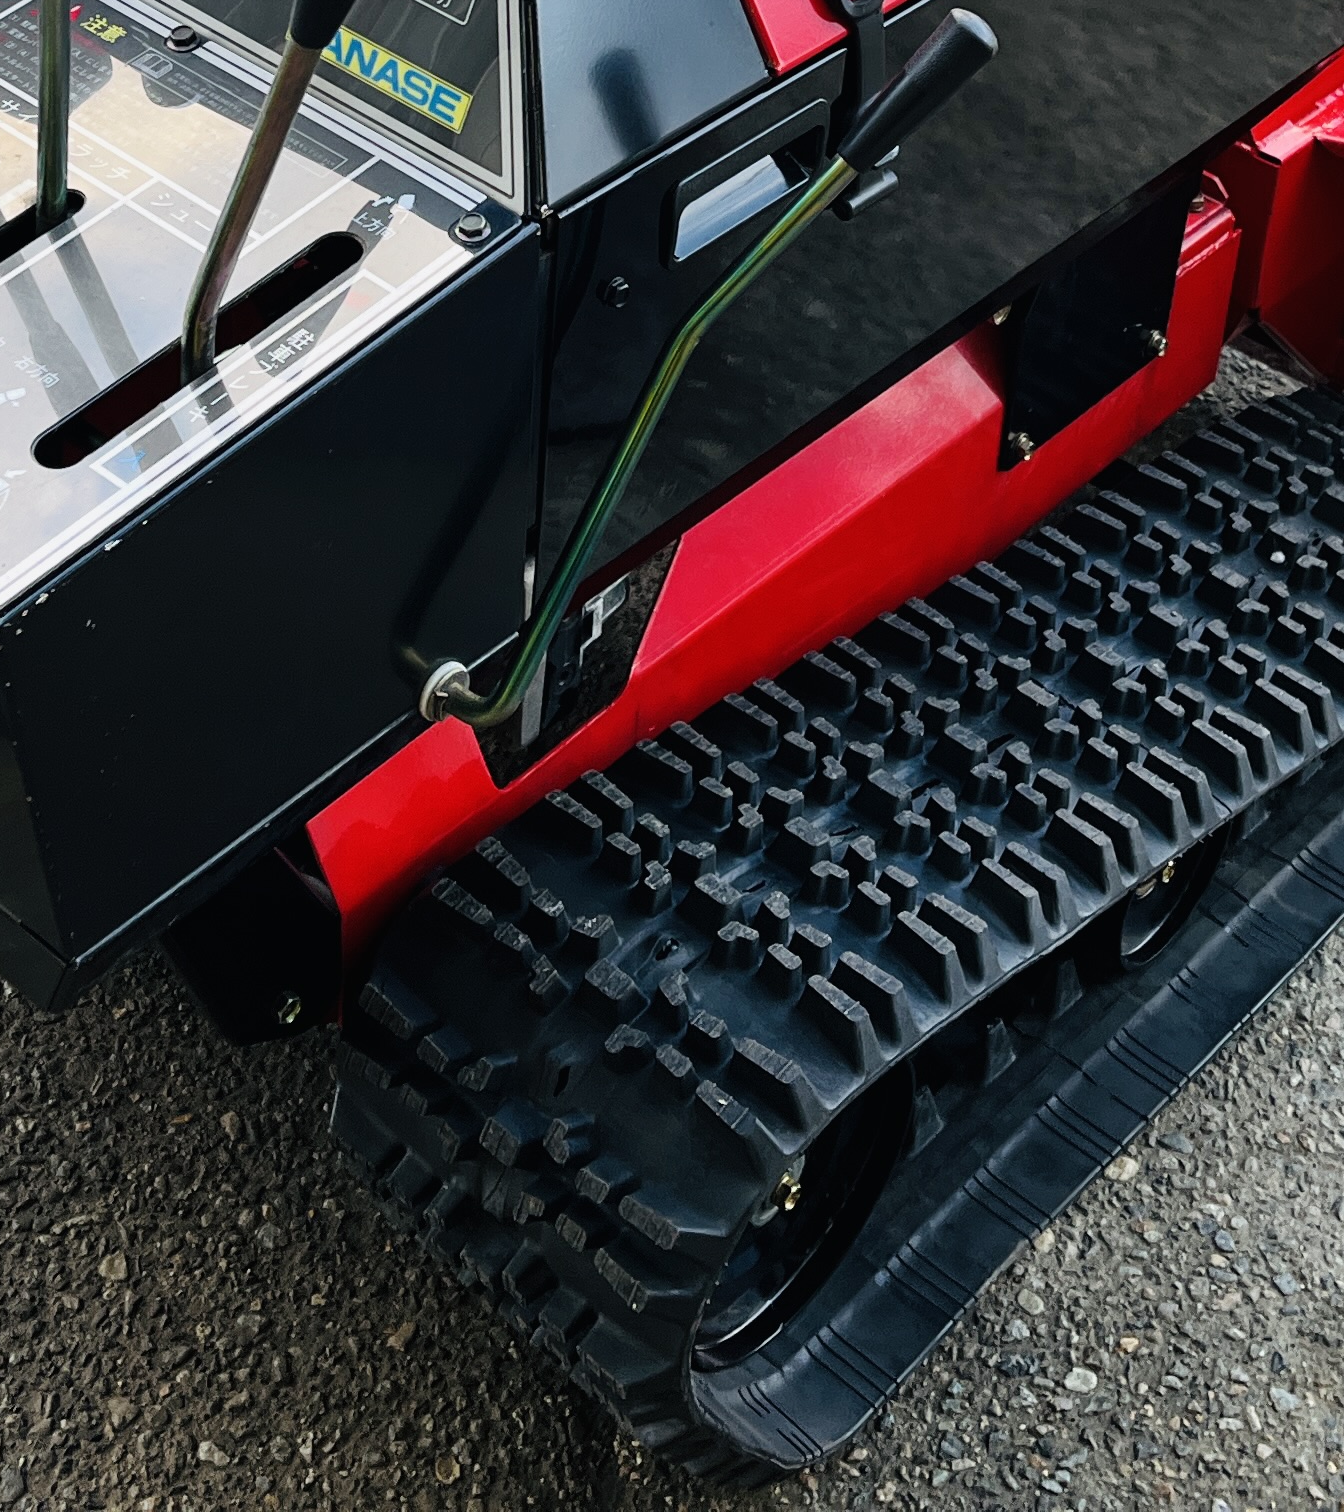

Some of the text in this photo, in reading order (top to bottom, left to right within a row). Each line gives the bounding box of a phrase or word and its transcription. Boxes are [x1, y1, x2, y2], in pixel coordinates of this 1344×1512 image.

[79, 14, 128, 44] 注意
[323, 31, 463, 125] ANASE
[0, 98, 132, 180] サイラッチ
[352, 211, 397, 241] 上方向
[13, 355, 60, 389] 右方向
